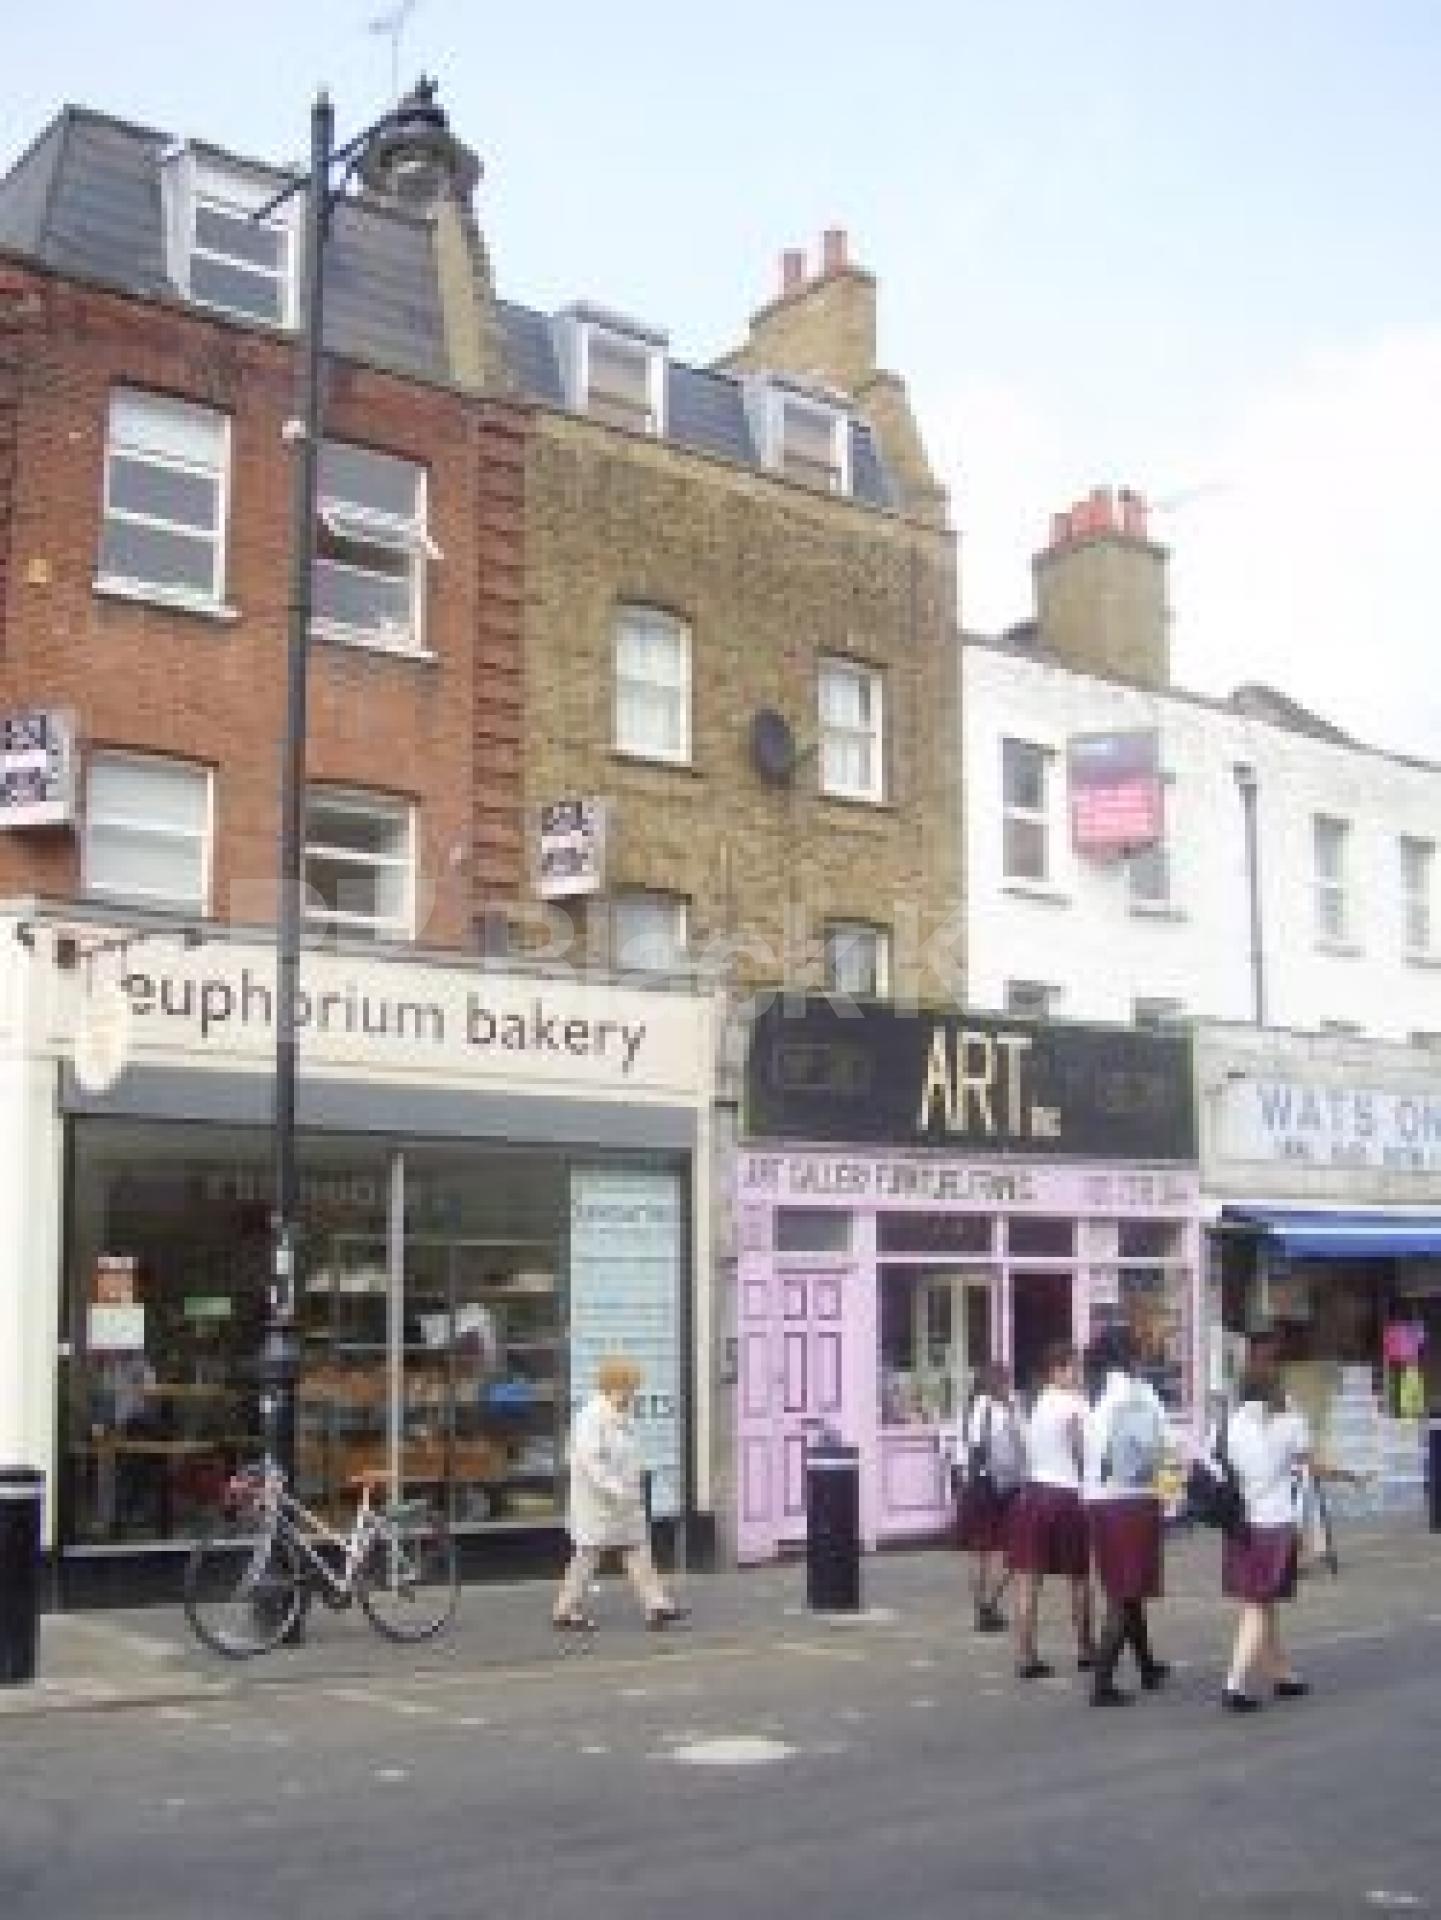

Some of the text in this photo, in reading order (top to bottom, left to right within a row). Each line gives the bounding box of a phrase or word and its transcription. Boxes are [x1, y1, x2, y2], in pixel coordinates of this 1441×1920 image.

[122, 968, 646, 1079] euphorium bakery
[921, 1026, 1033, 1136] ART
